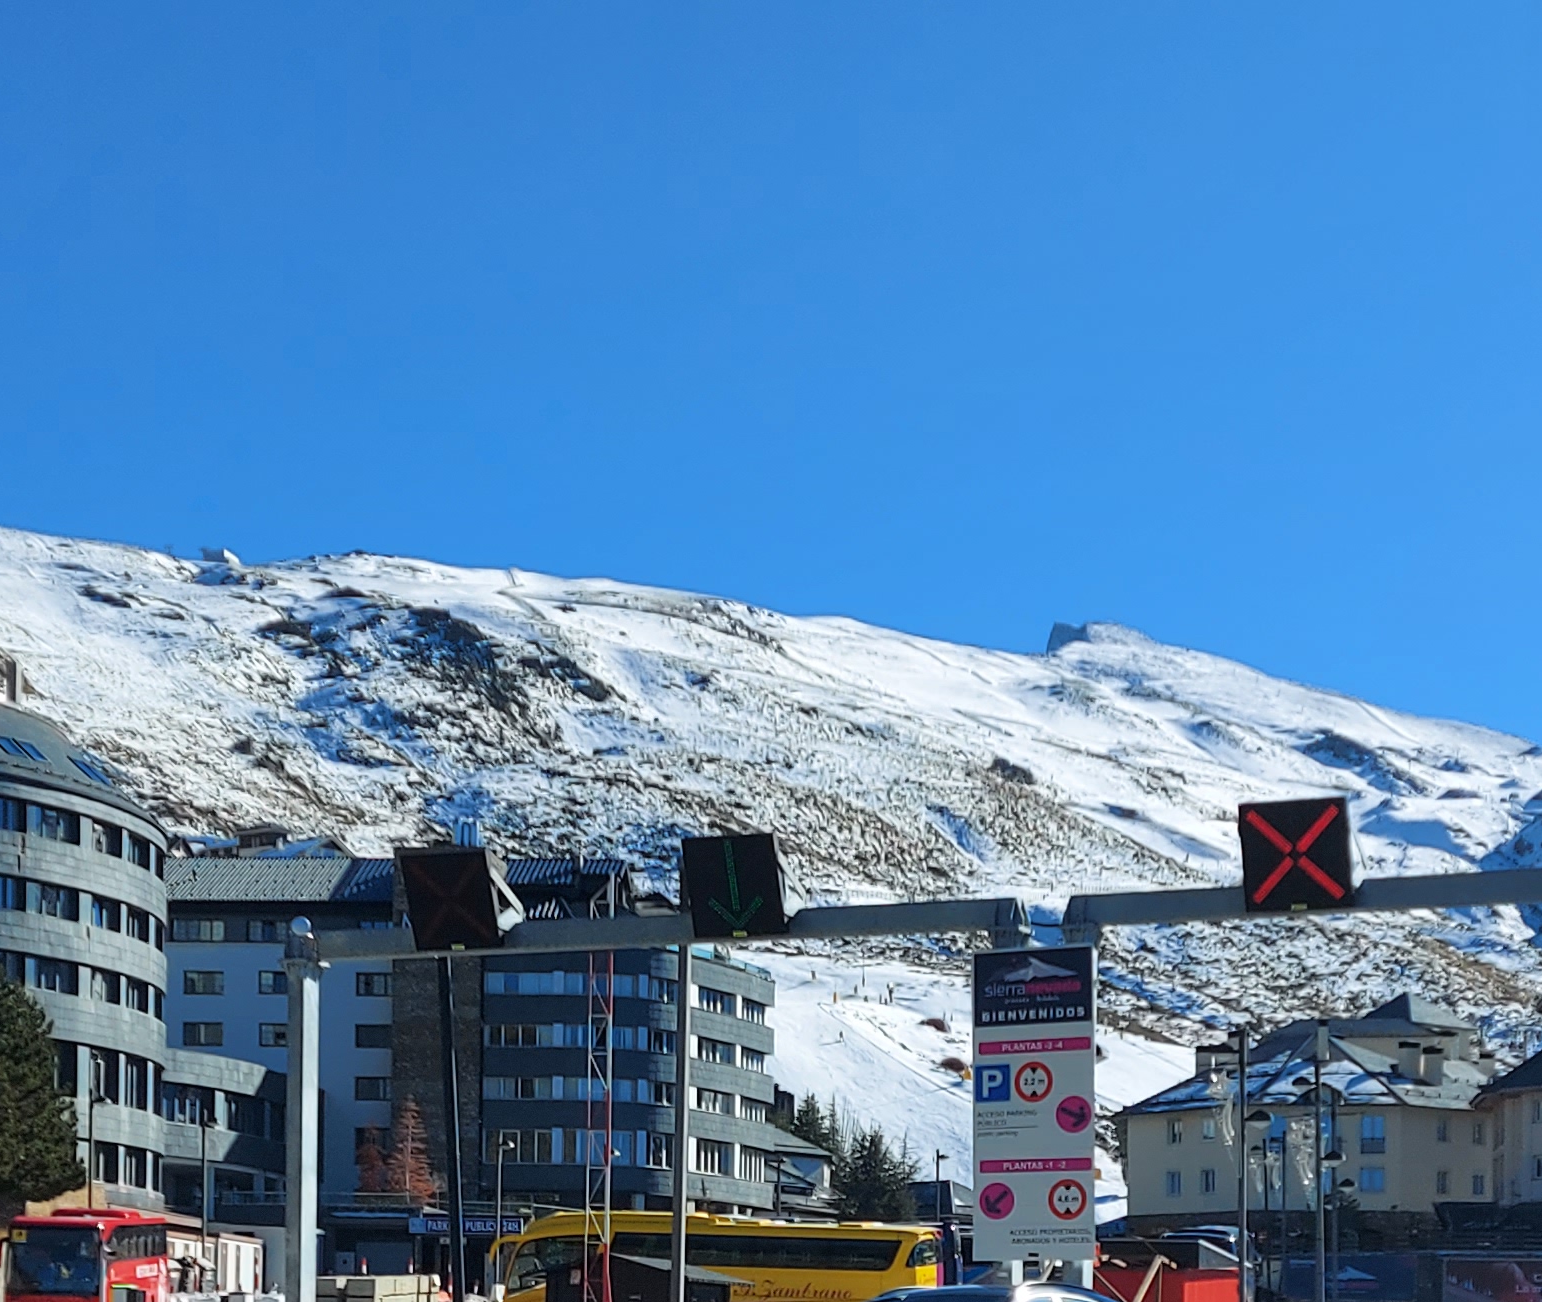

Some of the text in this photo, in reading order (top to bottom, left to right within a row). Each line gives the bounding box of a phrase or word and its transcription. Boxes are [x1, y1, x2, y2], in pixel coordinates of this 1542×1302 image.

[981, 1006, 1086, 1022] BIENVENIDOS
[1001, 1041, 1042, 1052] PLANTAS
[982, 1069, 1004, 1099] P
[1002, 1161, 1044, 1171] PLANTAS
